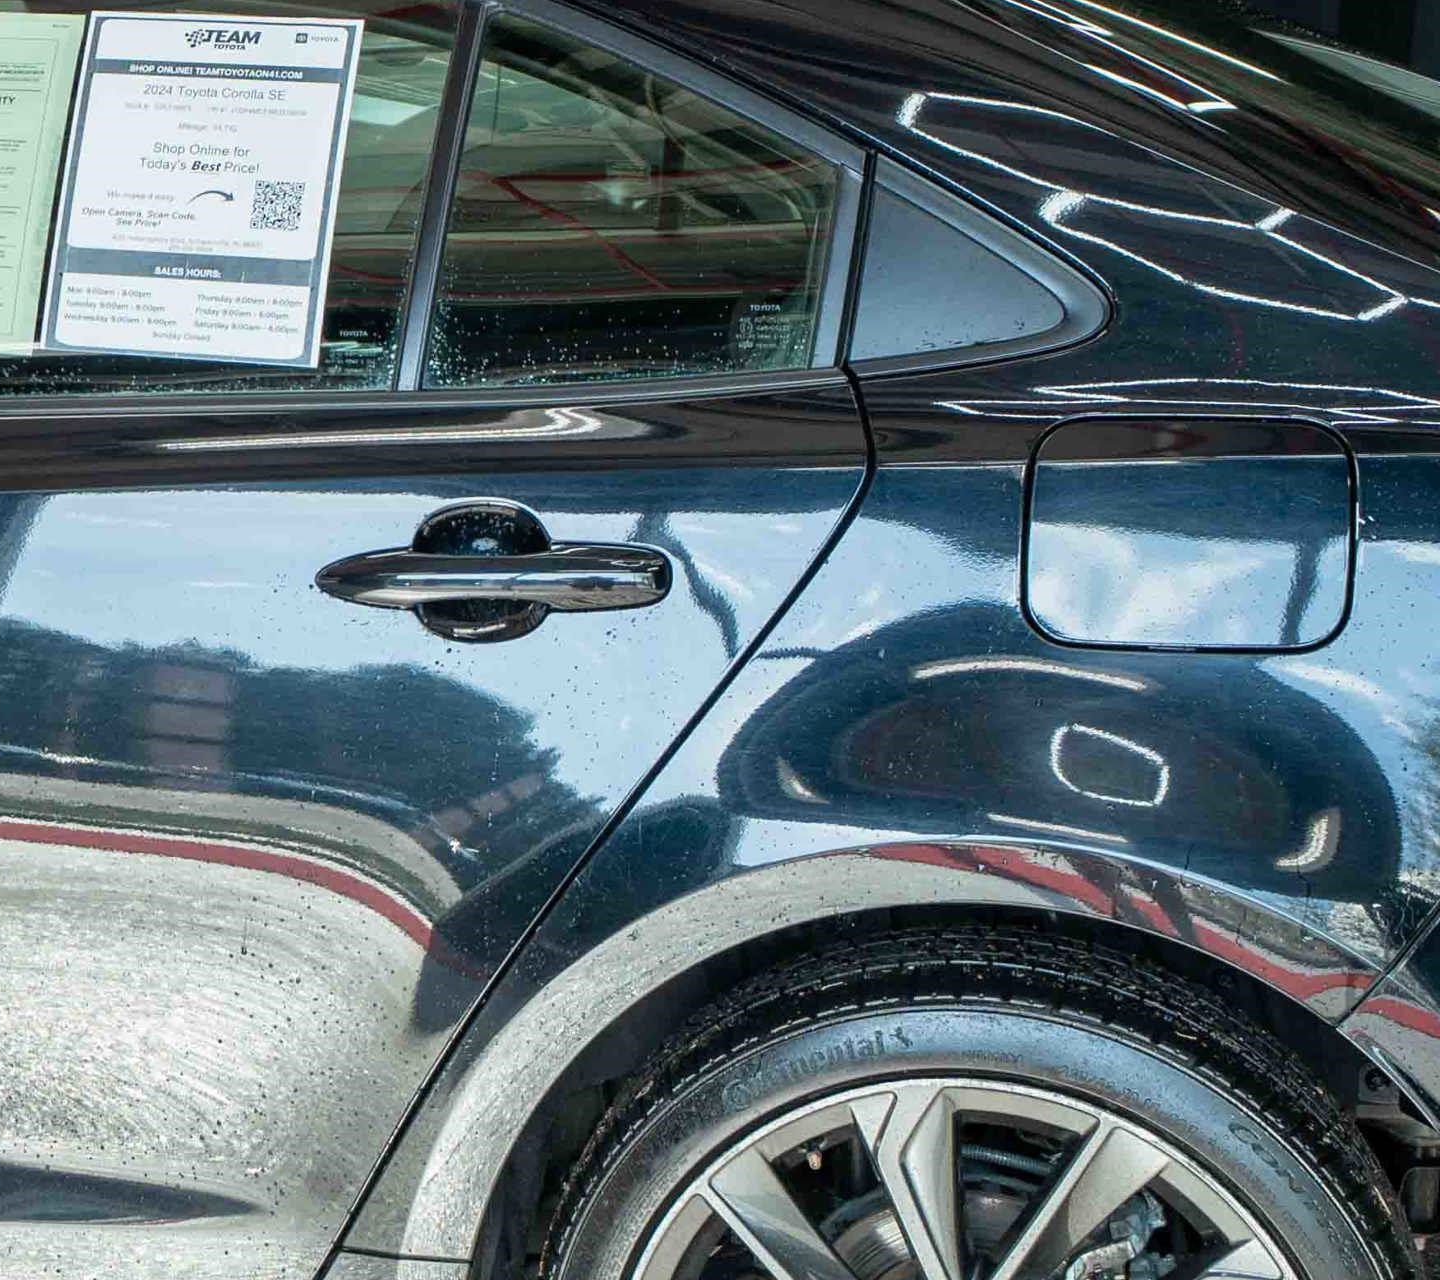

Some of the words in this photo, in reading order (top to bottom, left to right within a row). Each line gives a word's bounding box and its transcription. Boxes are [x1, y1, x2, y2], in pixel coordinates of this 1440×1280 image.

[204, 29, 262, 44] TEAM
[129, 64, 155, 73] SHOP
[156, 65, 193, 75] ONLINE!
[143, 84, 173, 96] 2024
[177, 85, 218, 98] Toyota
[221, 87, 264, 100] Corolla
[267, 89, 288, 101] SE
[153, 142, 185, 156] Shop
[189, 143, 230, 157] Online
[233, 145, 251, 157] for
[140, 157, 187, 173] Today's
[191, 160, 222, 172] Best
[223, 161, 260, 174] Price!
[81, 206, 106, 217] Open
[146, 209, 169, 219] Scan
[116, 217, 133, 226] See
[154, 265, 184, 276] SALES
[184, 268, 222, 279] HOURS:
[750, 304, 781, 312] TOYOTA
